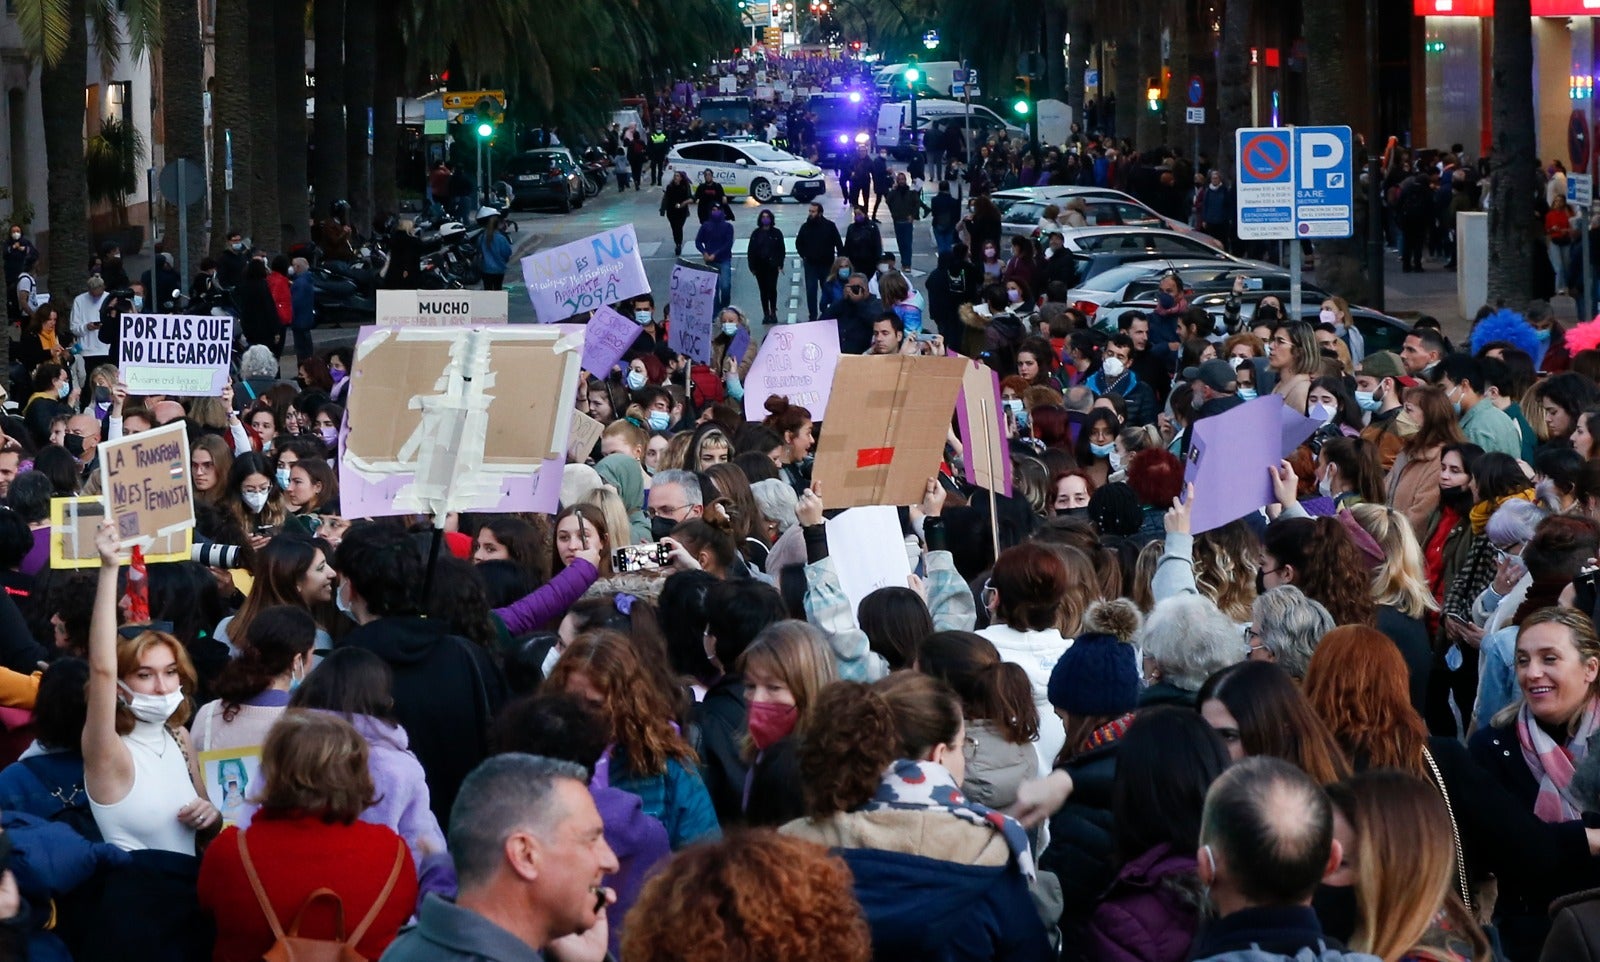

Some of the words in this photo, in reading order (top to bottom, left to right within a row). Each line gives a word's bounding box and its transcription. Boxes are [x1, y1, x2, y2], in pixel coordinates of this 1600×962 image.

[1301, 133, 1344, 189] P
[533, 252, 571, 280] NO
[575, 256, 588, 273] ES
[592, 233, 634, 266] NO
[419, 302, 469, 314] MUCHO
[123, 316, 157, 339] POR
[163, 318, 193, 340] LAS
[197, 319, 231, 341] QUE
[122, 341, 144, 363] NO
[148, 342, 229, 365] LLEGARON
[106, 449, 125, 476] LA
[132, 441, 181, 468] TRANSFOBIA
[113, 483, 126, 505] NO
[129, 483, 142, 504] ES
[143, 478, 189, 511] FEMINISTA
